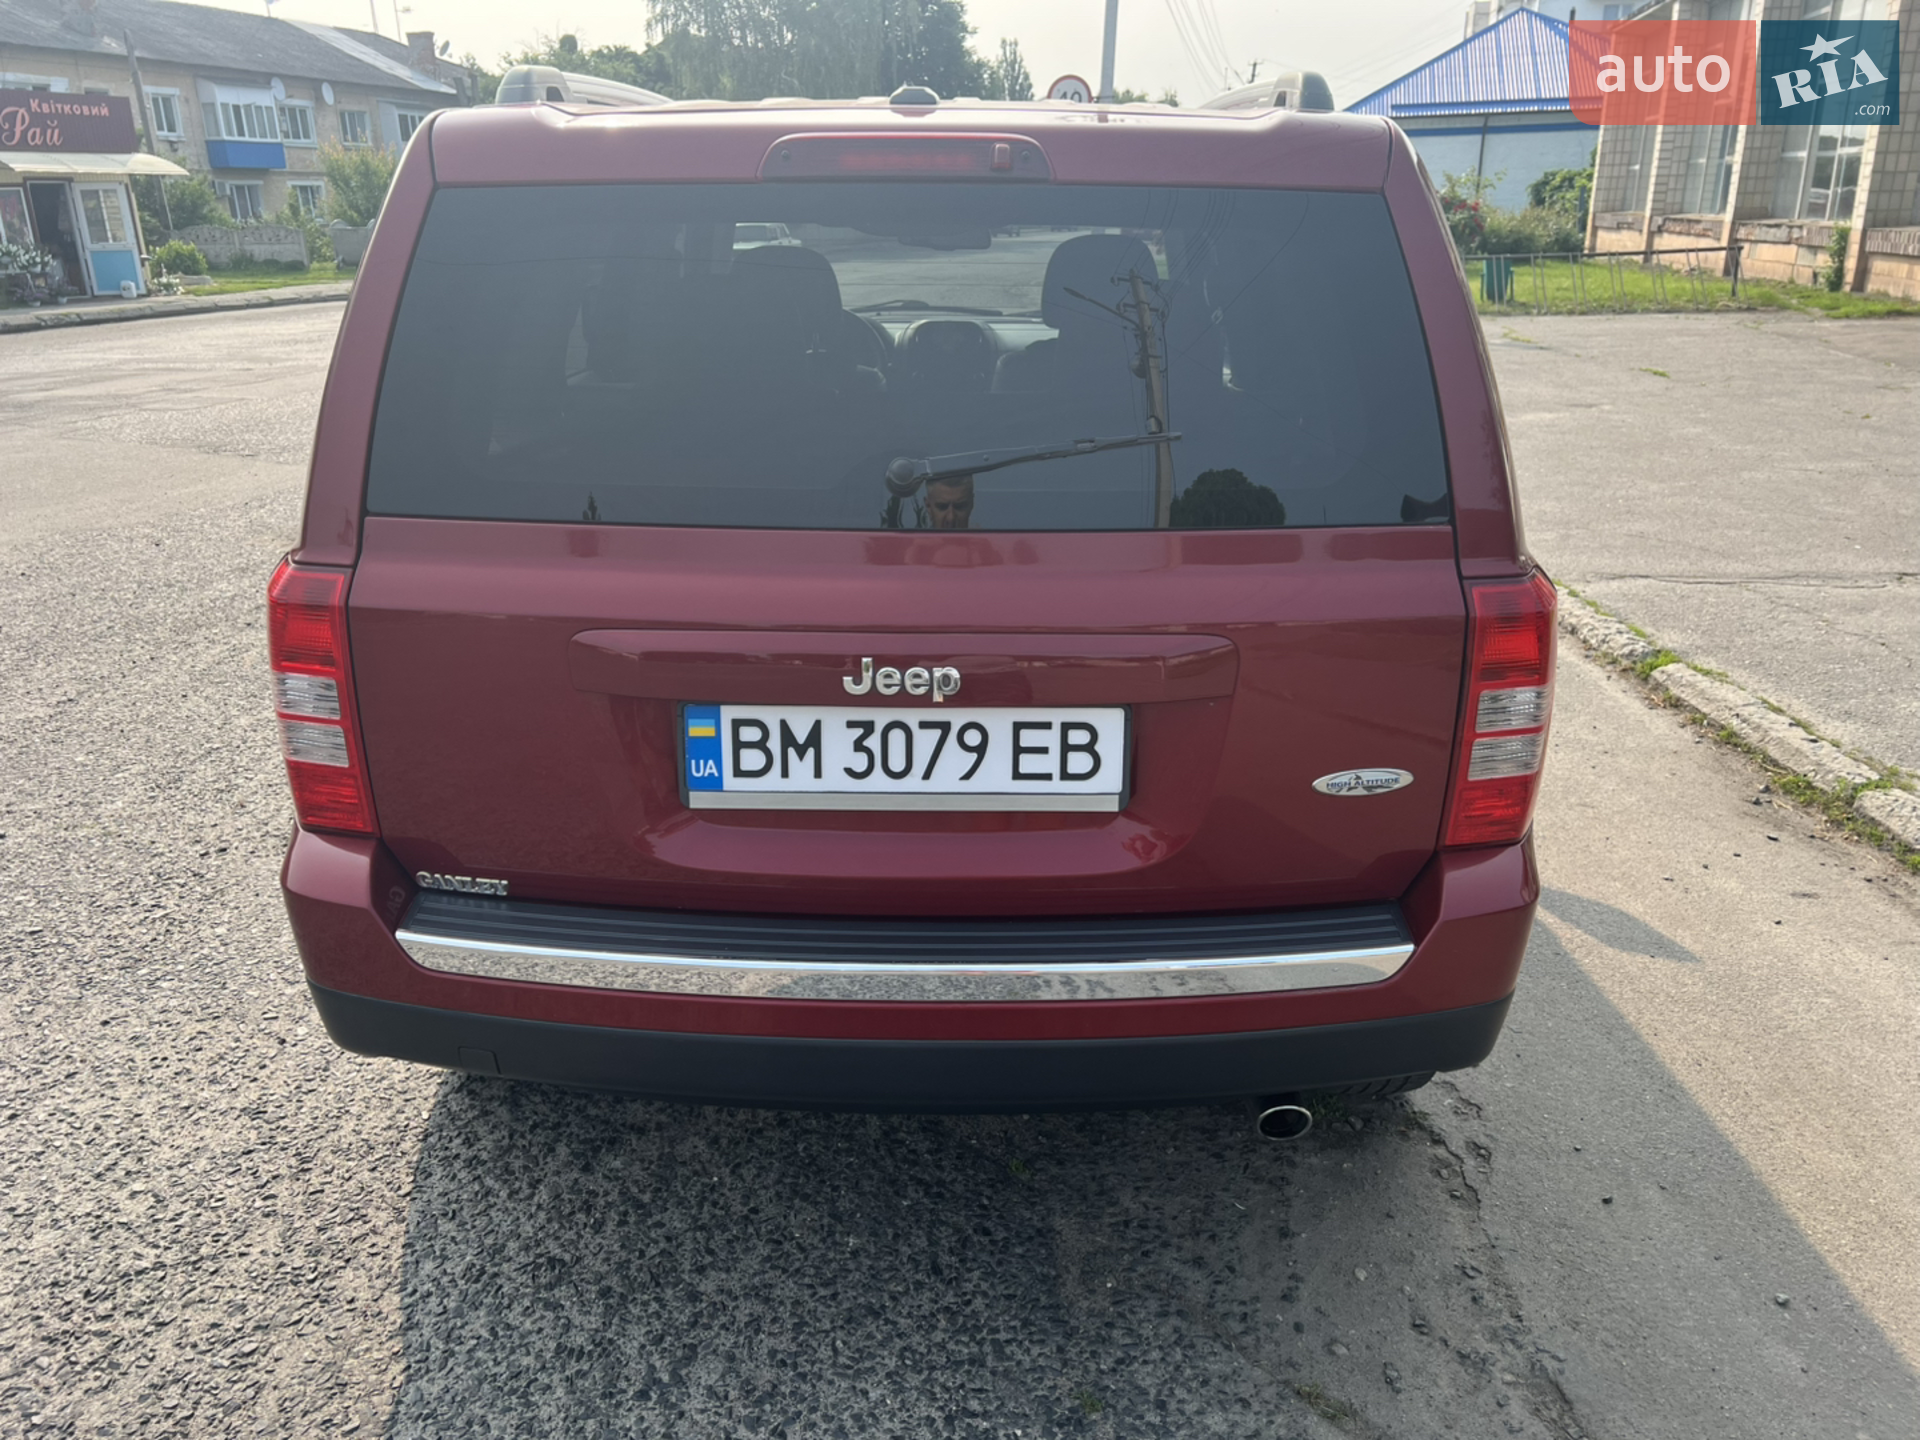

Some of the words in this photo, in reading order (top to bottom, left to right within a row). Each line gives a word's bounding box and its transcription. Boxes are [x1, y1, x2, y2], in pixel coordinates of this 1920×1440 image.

[29, 98, 110, 117] Квітковий
[0, 106, 63, 146] Рай
[842, 657, 961, 702] Jeep
[730, 718, 822, 779] BM
[843, 720, 989, 781] 3079
[1012, 721, 1102, 781] EB
[690, 759, 719, 778] UA
[1326, 780, 1352, 789] HIGH
[1354, 777, 1401, 787] ALTITUDE
[415, 870, 509, 896] GANLEY
